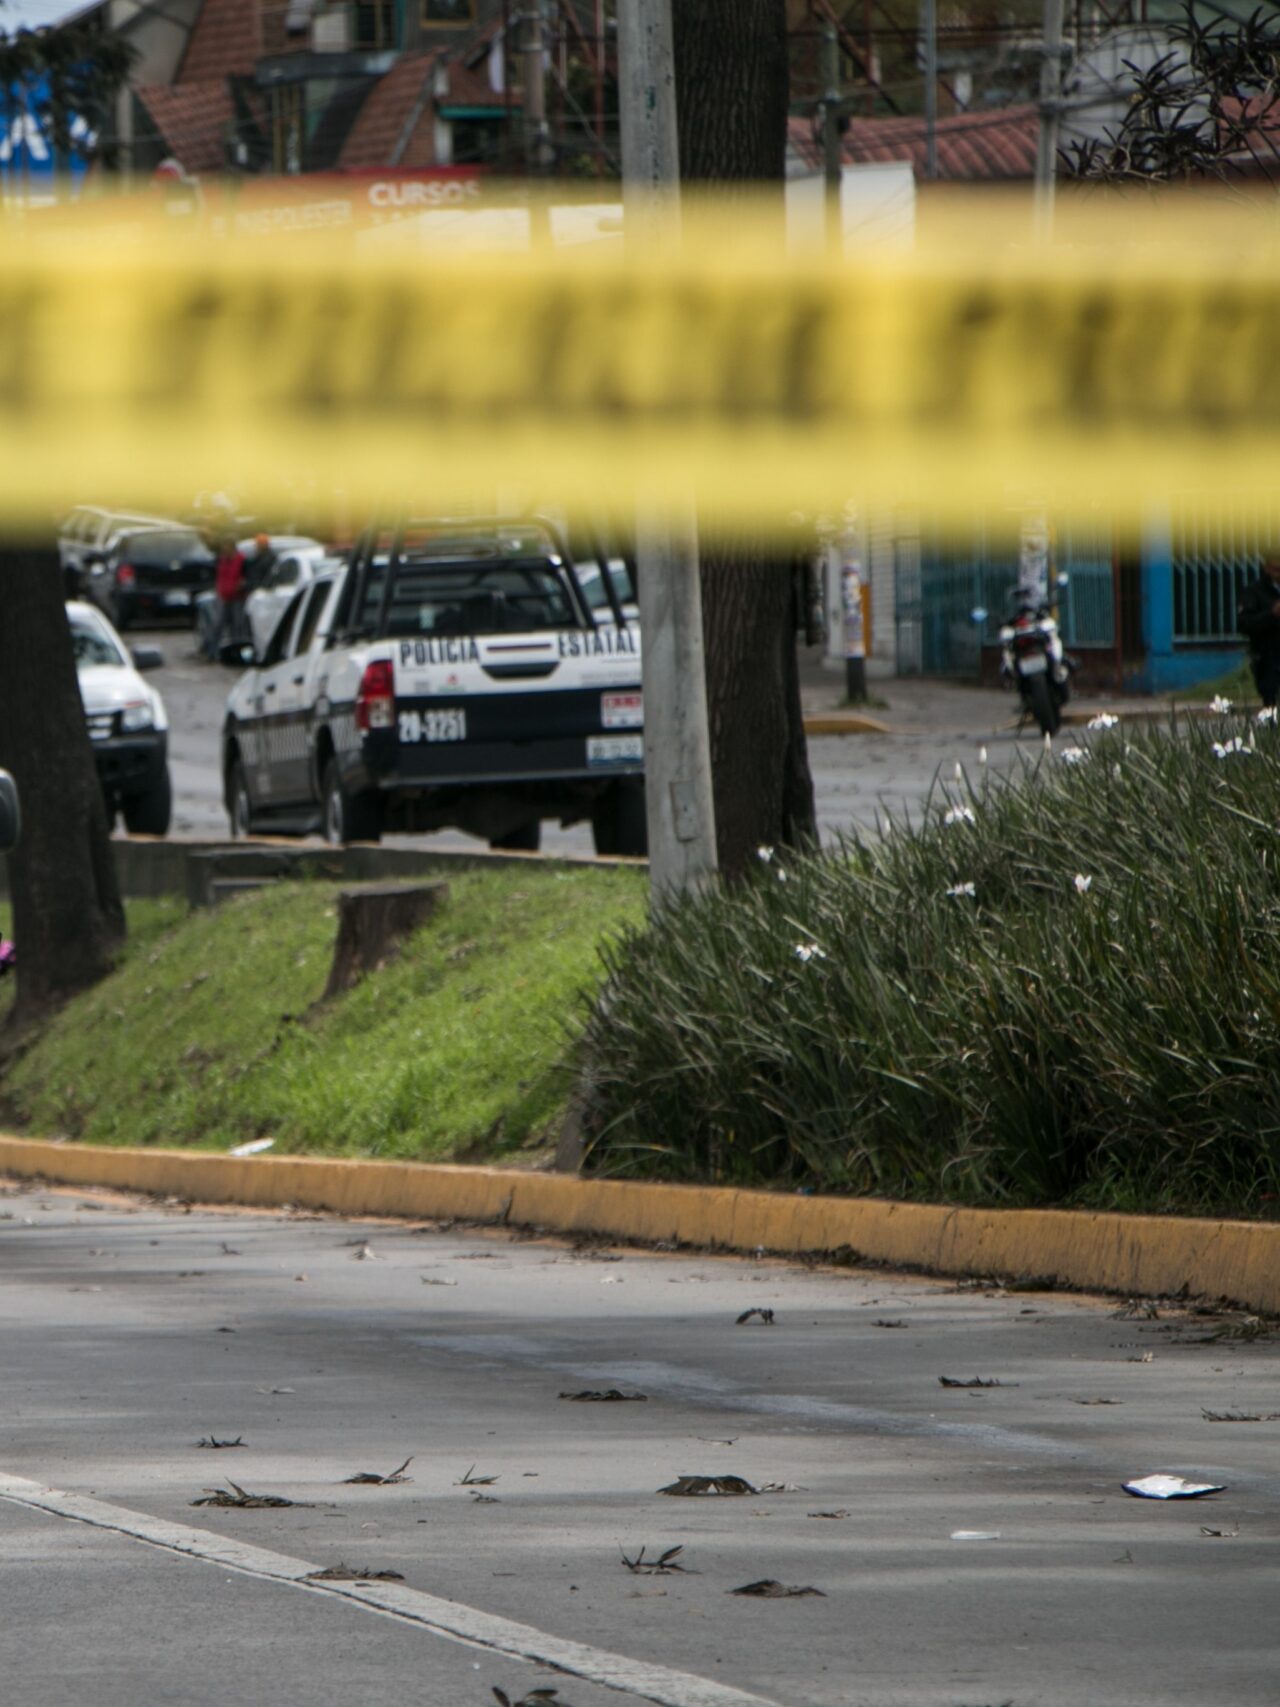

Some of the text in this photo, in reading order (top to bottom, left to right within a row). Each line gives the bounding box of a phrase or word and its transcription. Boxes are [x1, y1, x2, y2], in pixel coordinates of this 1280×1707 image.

[369, 180, 480, 208] CURSOS
[400, 626, 638, 667] POLICIA ESTATAL
